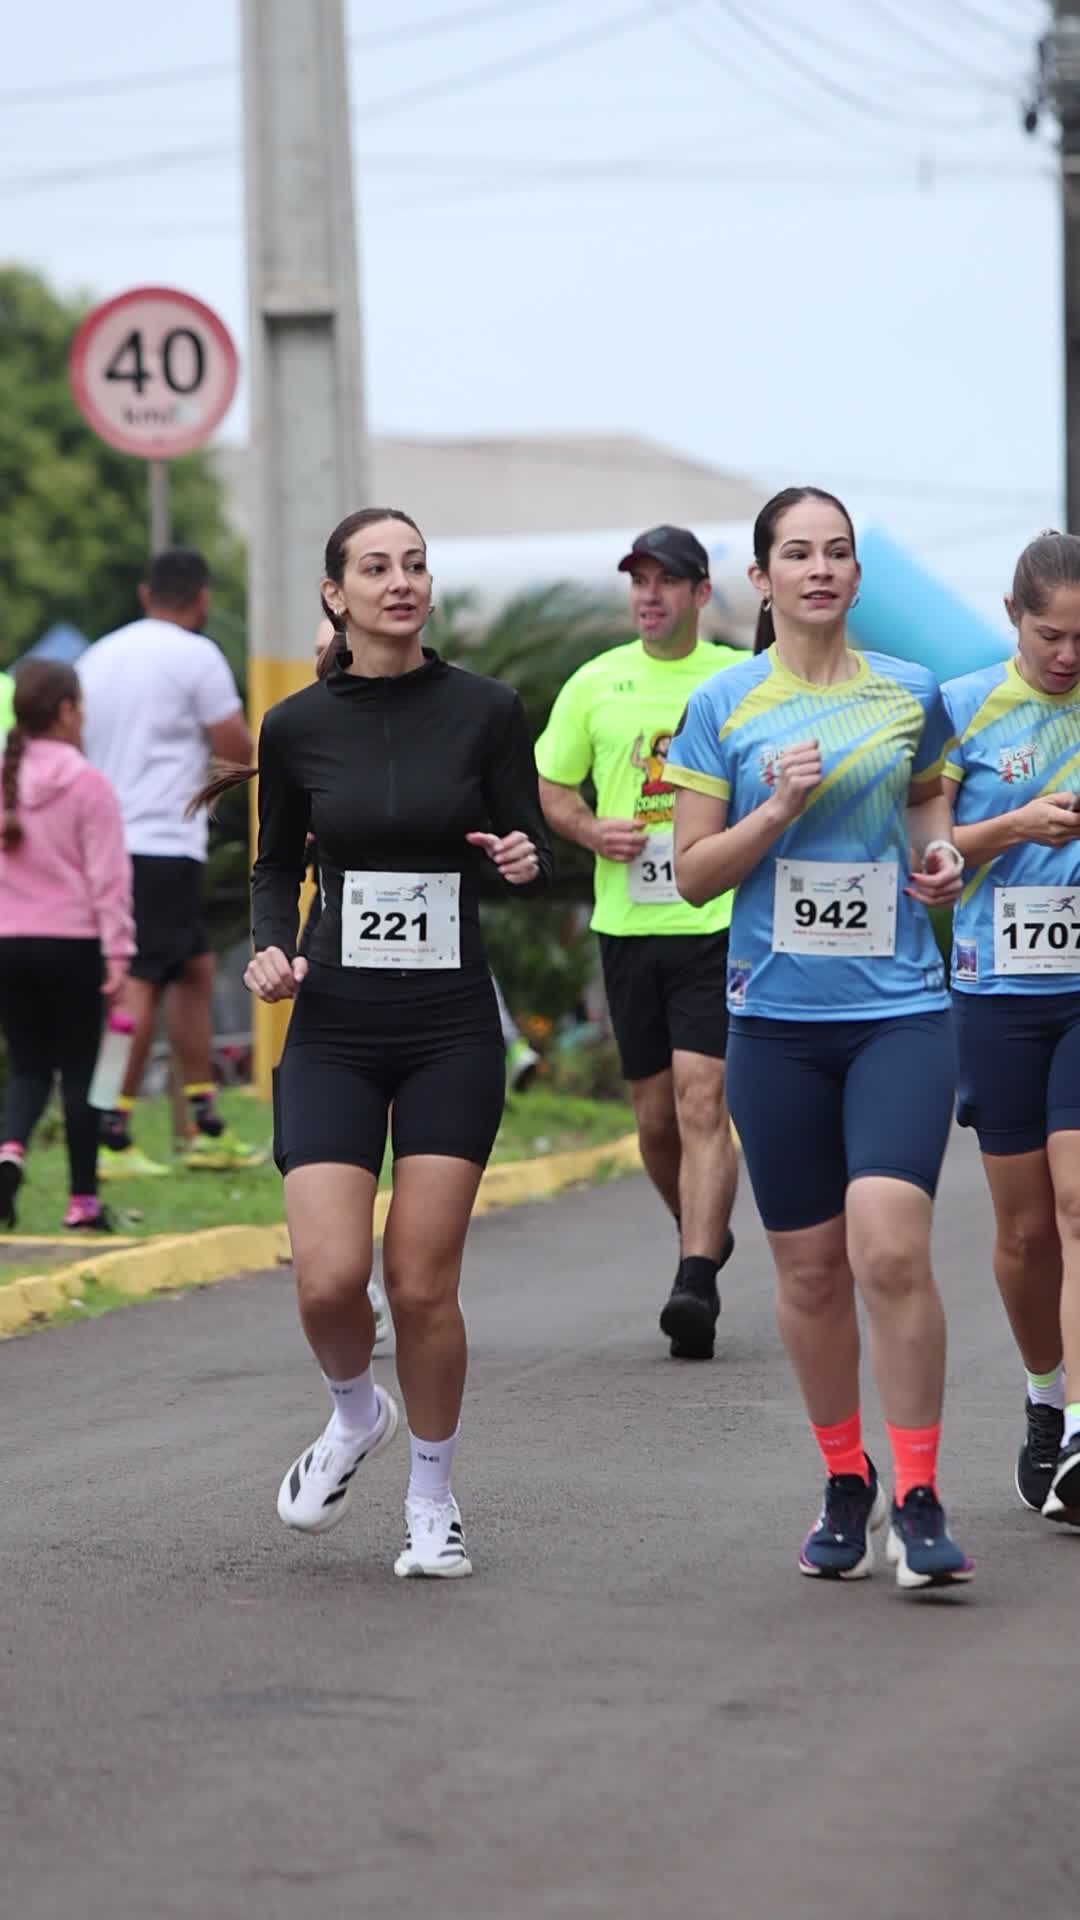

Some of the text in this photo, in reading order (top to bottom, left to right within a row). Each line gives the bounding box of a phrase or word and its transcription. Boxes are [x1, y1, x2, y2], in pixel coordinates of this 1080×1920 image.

[105, 328, 206, 394] 40
[359, 911, 427, 942] 221
[795, 898, 868, 928] 942
